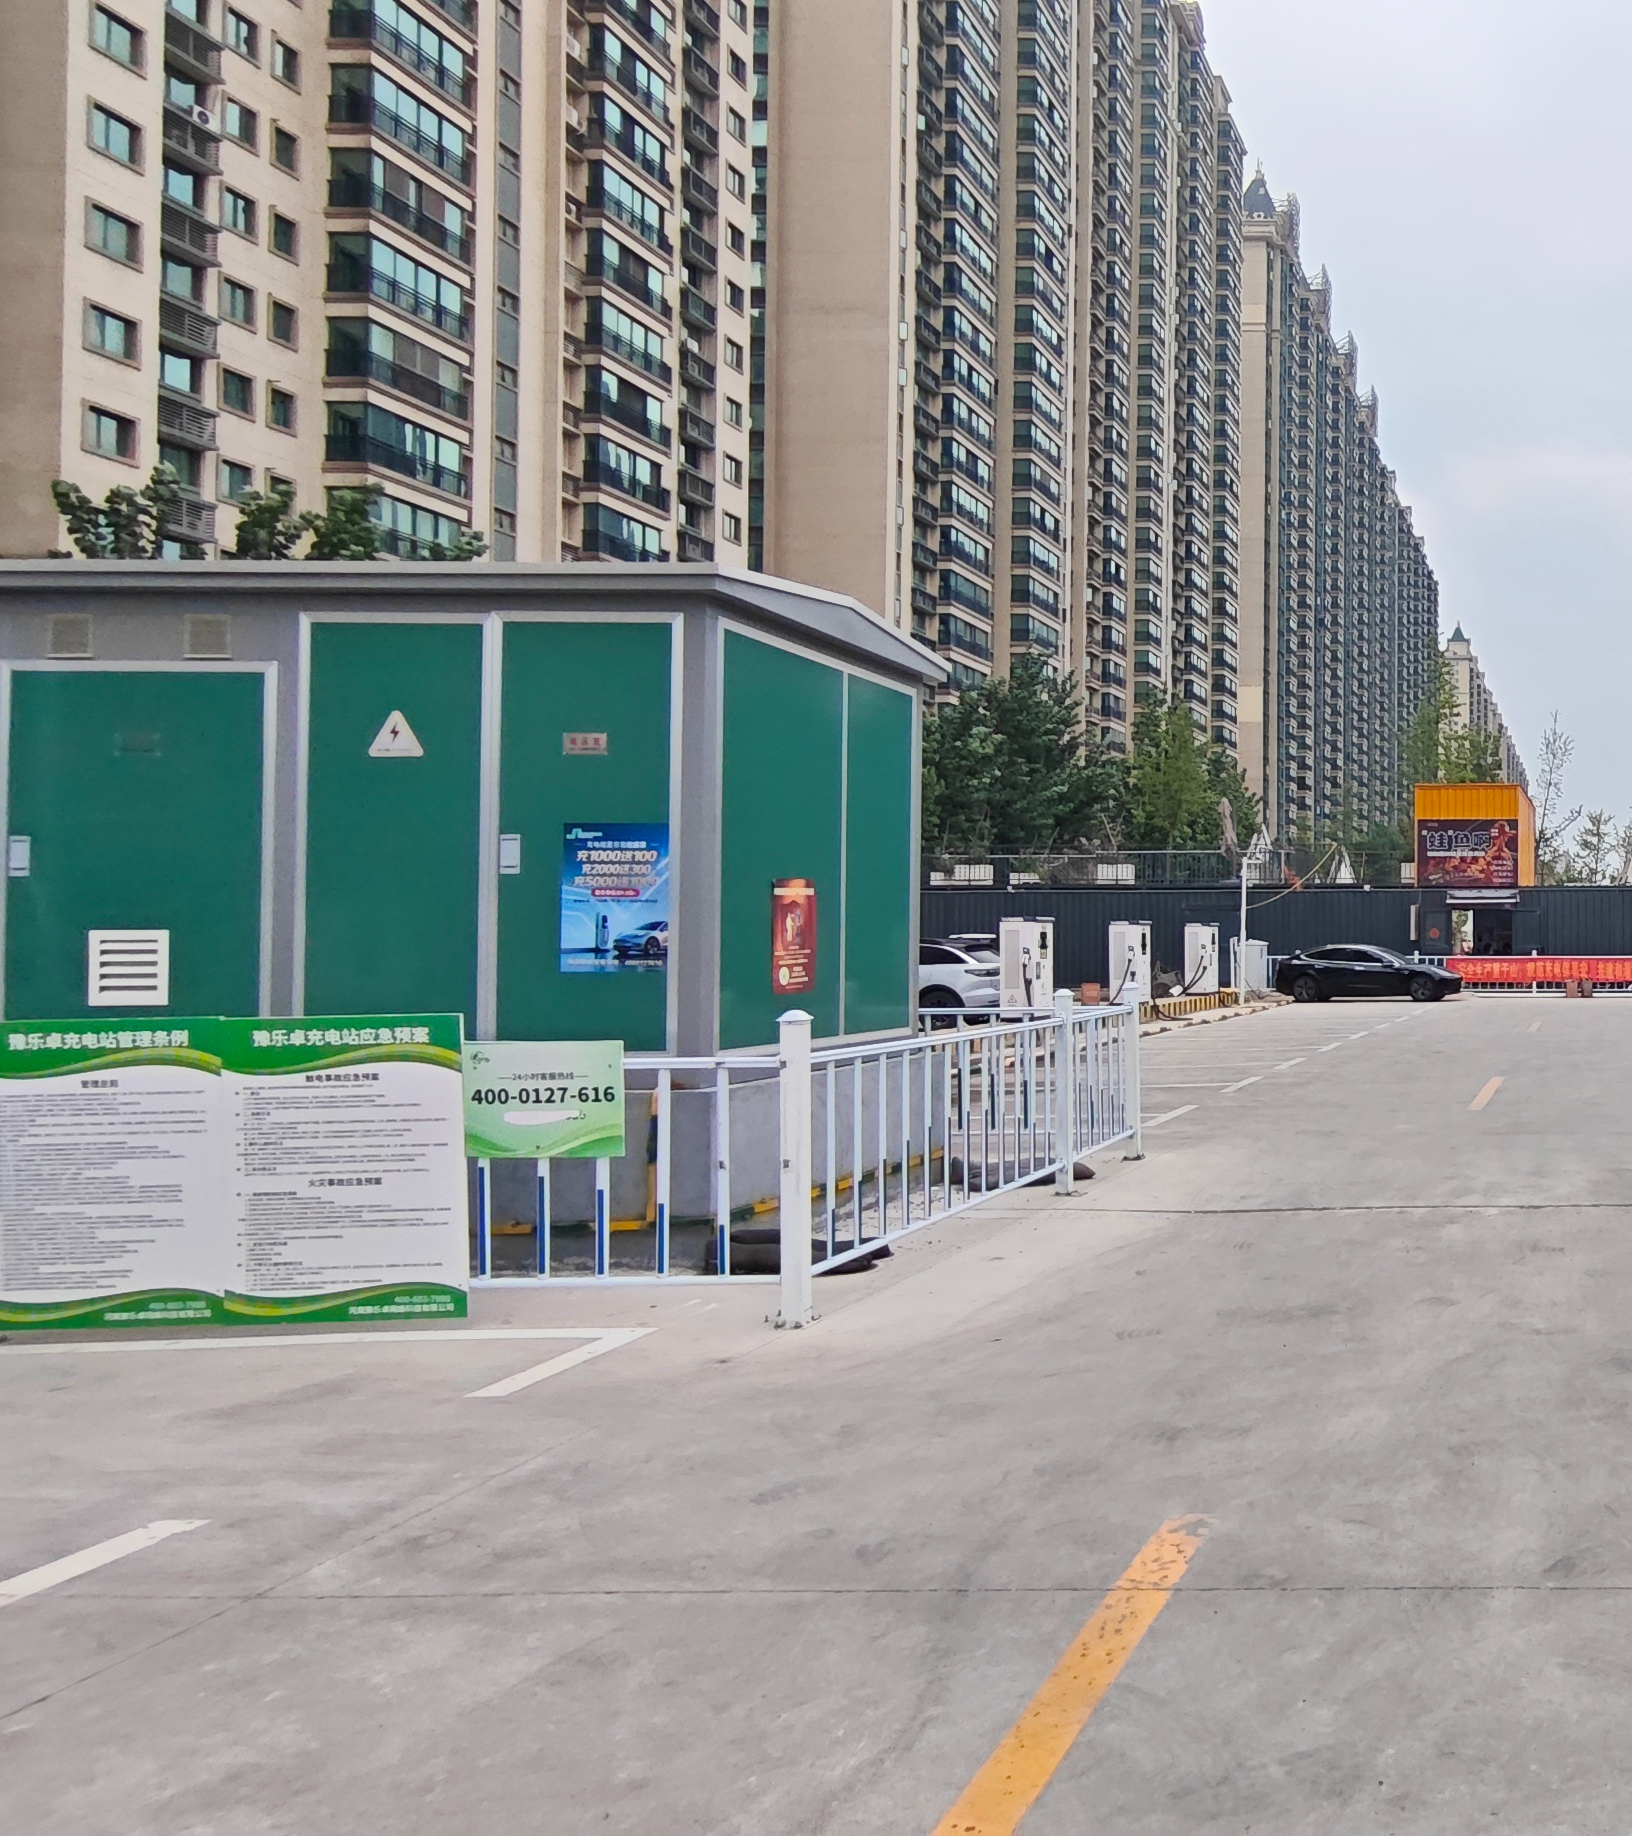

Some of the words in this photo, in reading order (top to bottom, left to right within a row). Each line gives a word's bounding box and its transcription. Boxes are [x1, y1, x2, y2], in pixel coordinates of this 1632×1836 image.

[576, 850, 658, 862] 充1000送100
[8, 1029, 189, 1050] 豫乐卓充电站管理条例
[252, 1026, 430, 1047] 豫乐卓充电站应急预案
[471, 1085, 616, 1105] 400-0127-616
[307, 1177, 383, 1188] 火灾事故应急预案
